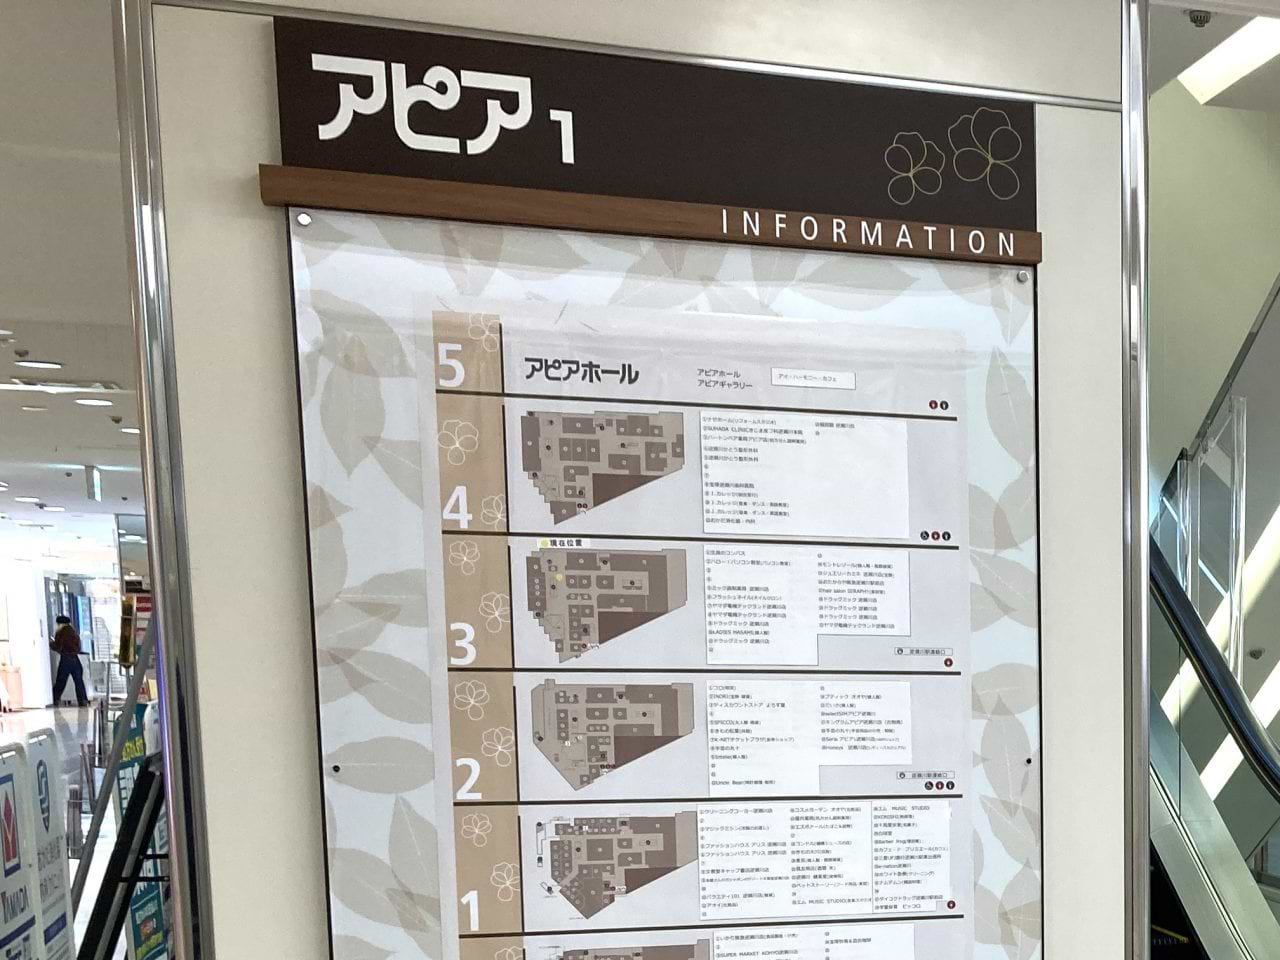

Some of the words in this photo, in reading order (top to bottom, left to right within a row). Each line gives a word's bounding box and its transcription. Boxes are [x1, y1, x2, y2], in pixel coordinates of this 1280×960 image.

[720, 208, 1017, 257] INFORMATION
[437, 343, 466, 388] 5
[524, 357, 640, 385] アピアホール
[441, 486, 473, 529] 4
[550, 539, 582, 547] 現在位置
[450, 622, 477, 666] 3
[455, 757, 482, 800] 2
[460, 890, 480, 932] 1
